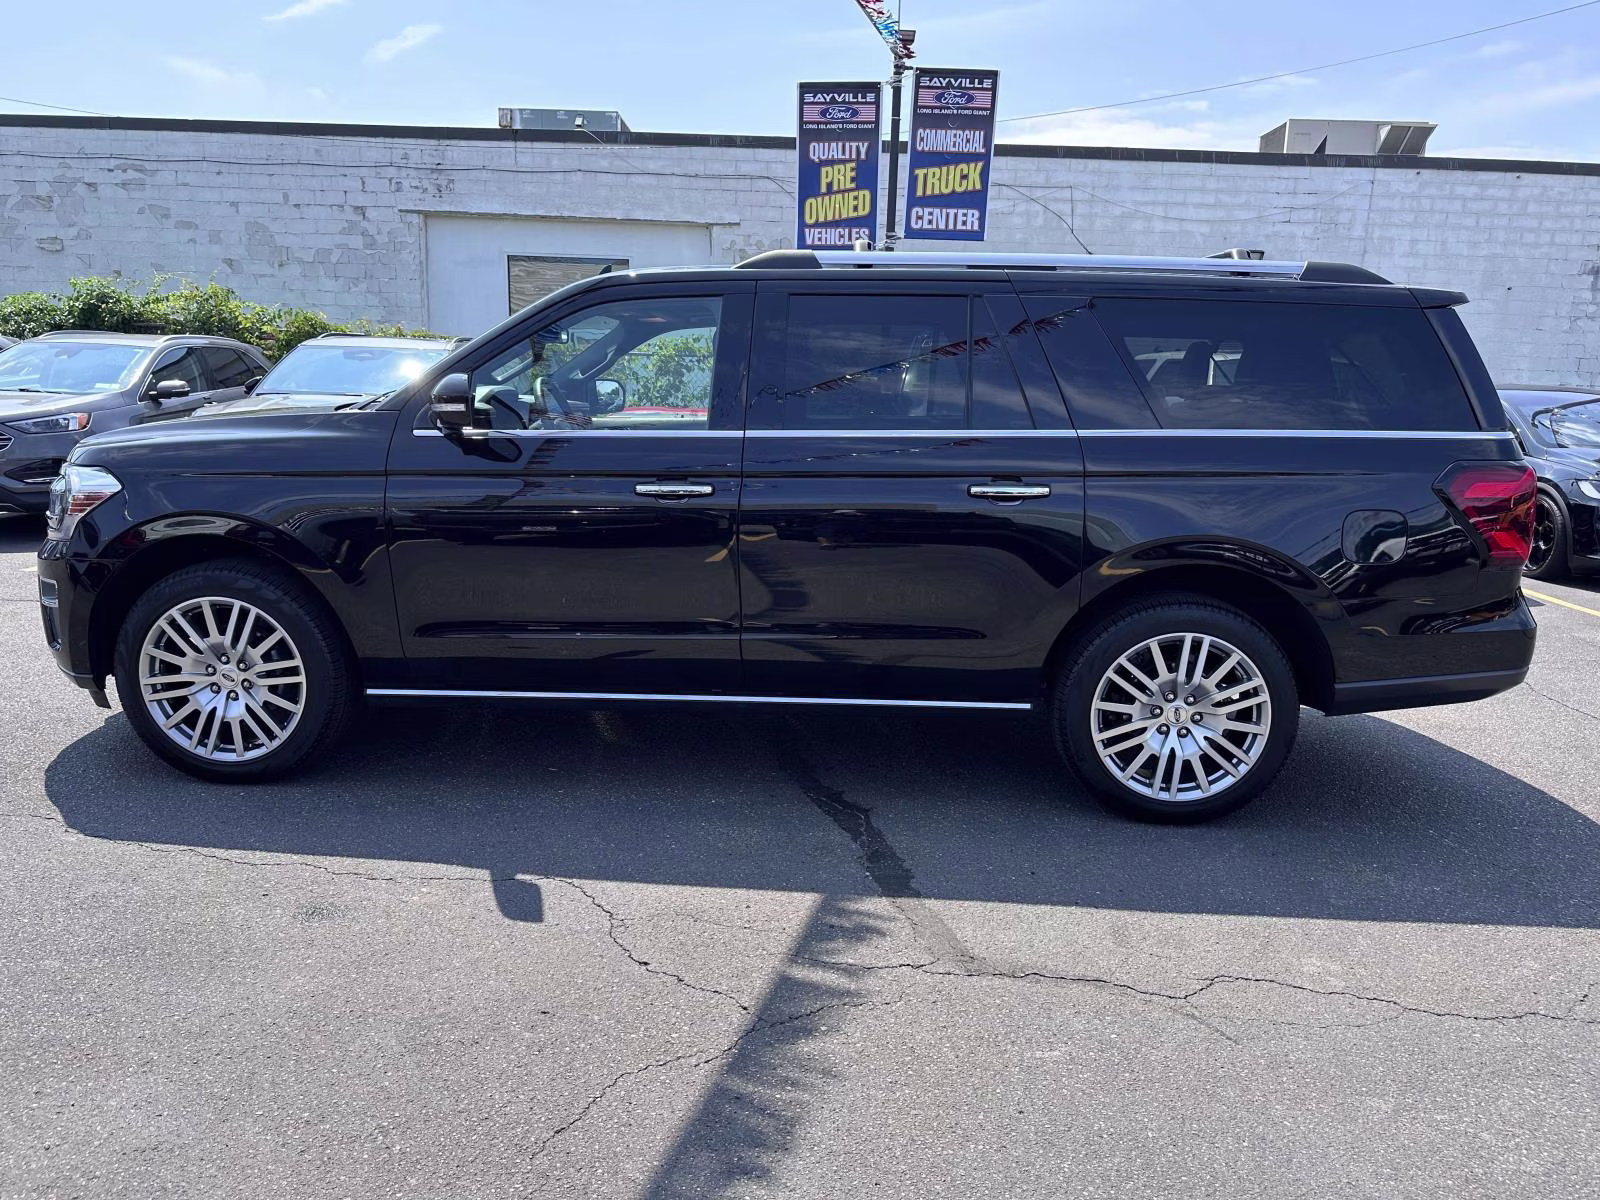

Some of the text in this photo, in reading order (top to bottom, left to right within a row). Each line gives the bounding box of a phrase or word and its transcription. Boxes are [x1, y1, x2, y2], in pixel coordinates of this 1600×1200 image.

[919, 77, 993, 88] SAYVILLE
[803, 93, 876, 102] SAYVILLE
[941, 91, 968, 104] Ford
[826, 106, 853, 119] Ford
[916, 129, 985, 153] COMMERCIAL
[809, 142, 869, 162] QUALITY
[820, 163, 857, 193] PRE
[914, 162, 985, 197] TRUCK
[805, 190, 871, 224] OWNED
[911, 207, 981, 231] CENTER
[804, 228, 870, 245] VEHICLES
